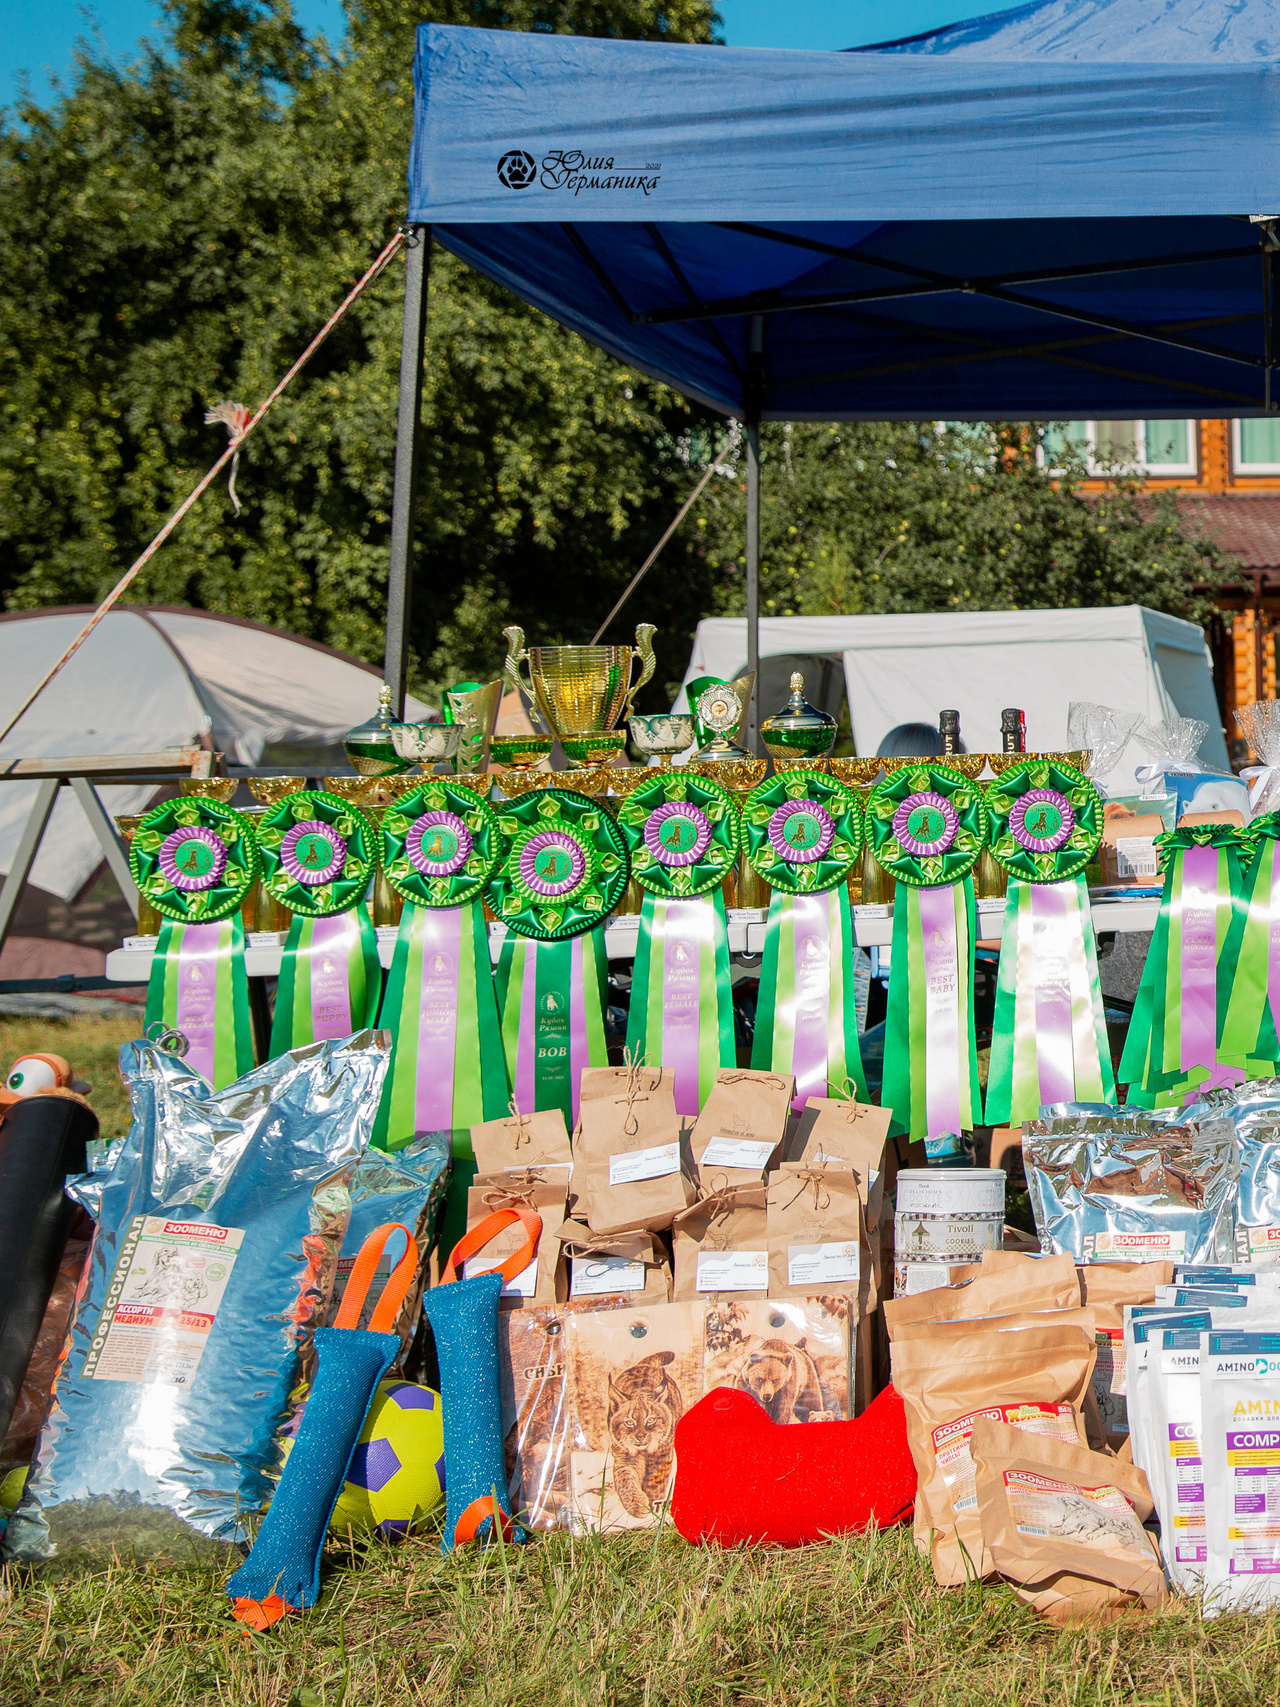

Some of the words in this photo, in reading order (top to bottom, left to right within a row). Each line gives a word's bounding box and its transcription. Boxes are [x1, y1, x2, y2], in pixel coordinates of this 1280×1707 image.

[945, 734, 953, 756] RUT
[1007, 734, 1015, 753] UT
[930, 974, 954, 986] BEST
[930, 983, 955, 995] BABY
[319, 1005, 343, 1013] BEST
[664, 1001, 699, 1009] FEMALE
[185, 1014, 208, 1022] BEST
[315, 1013, 348, 1023] PUPPY
[421, 1009, 456, 1018] JUNIOR
[538, 1047, 567, 1058] BOB
[166, 1223, 226, 1238] ЗООМЕНЮ
[947, 1225, 974, 1233] Tivoli
[1114, 1235, 1170, 1245] ЗООМЕНЮ
[82, 1216, 145, 1377] ПРОФЕССИОНАЛ
[116, 1304, 154, 1315] АССОРТИ
[113, 1314, 154, 1325] МЕДИУМ
[180, 1316, 207, 1328] 25/13
[1170, 1356, 1199, 1366] AMIN
[524, 1364, 566, 1379] СИБИ
[1021, 1406, 1039, 1415] Био
[938, 1438, 963, 1453] НОВИНКА!
[938, 1440, 971, 1459] ПРОТЕИНОВ
[941, 1453, 961, 1465] ЧИПСЫ
[1009, 1472, 1077, 1491] ЗООМЕНЮ
